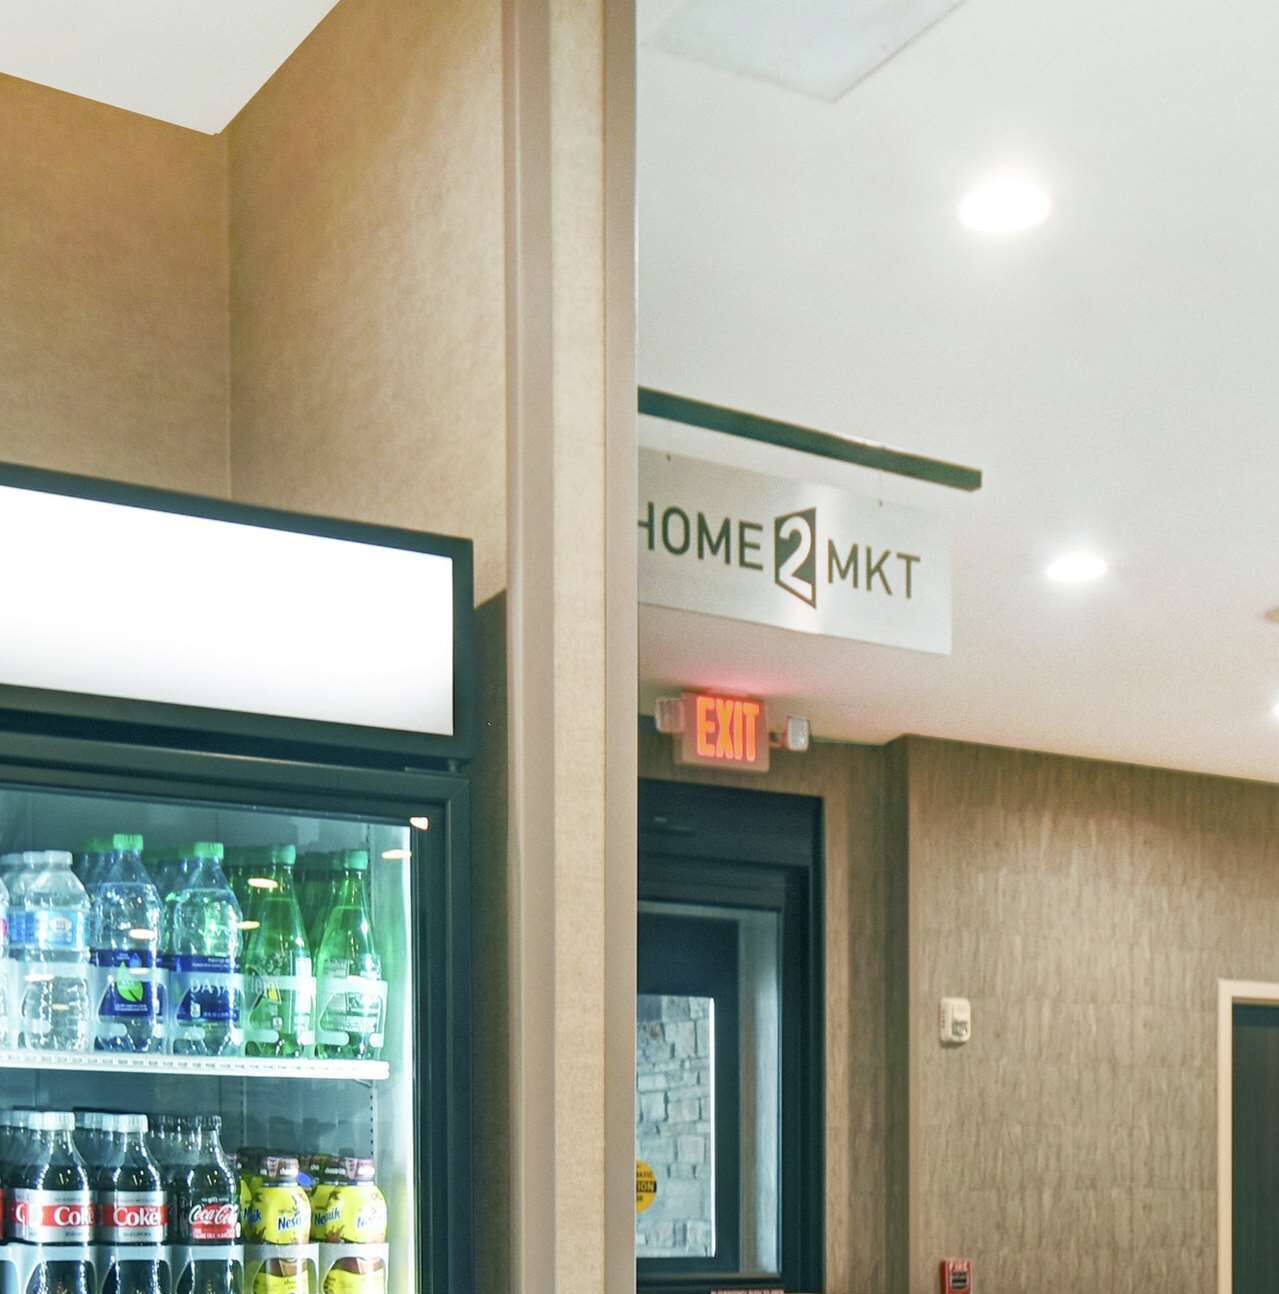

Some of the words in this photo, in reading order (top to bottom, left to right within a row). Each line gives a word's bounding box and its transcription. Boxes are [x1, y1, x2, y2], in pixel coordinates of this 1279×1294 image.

[638, 501, 763, 571] HOME
[827, 538, 920, 599] MKT
[696, 696, 760, 763] EXIT
[113, 1206, 160, 1227] Coke
